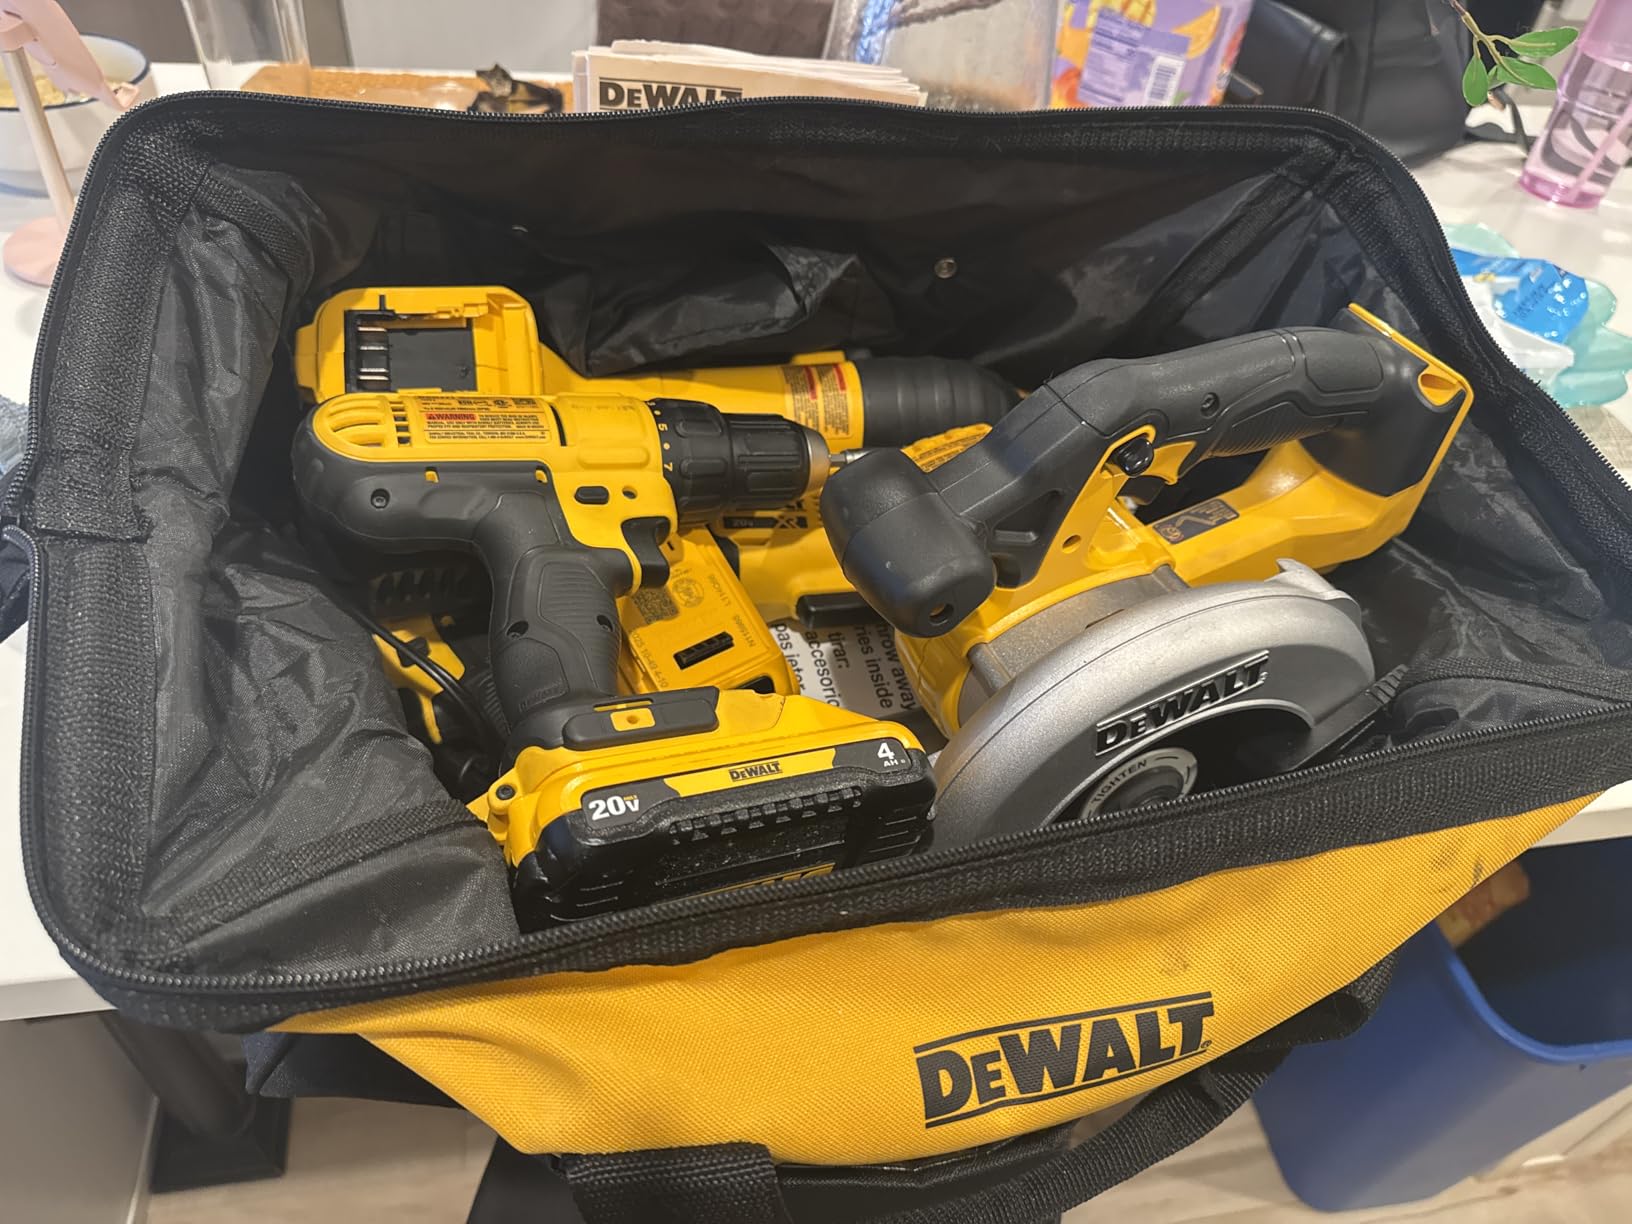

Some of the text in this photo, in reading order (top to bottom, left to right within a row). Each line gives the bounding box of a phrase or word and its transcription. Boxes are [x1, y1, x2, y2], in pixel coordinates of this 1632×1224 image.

[658, 423, 668, 431] 5
[664, 462, 673, 471] 7
[775, 623, 792, 650] pas
[828, 632, 849, 669] tirar:
[877, 624, 916, 711] hrow away
[865, 658, 893, 709] inside
[1097, 658, 1268, 752] DEWALT
[878, 742, 895, 759] 4
[884, 759, 898, 767] AH
[730, 762, 780, 780] DEWALT
[1091, 759, 1147, 803] TIGHTEN
[588, 796, 639, 821] 20V
[916, 1001, 1214, 1120] DEWALT
